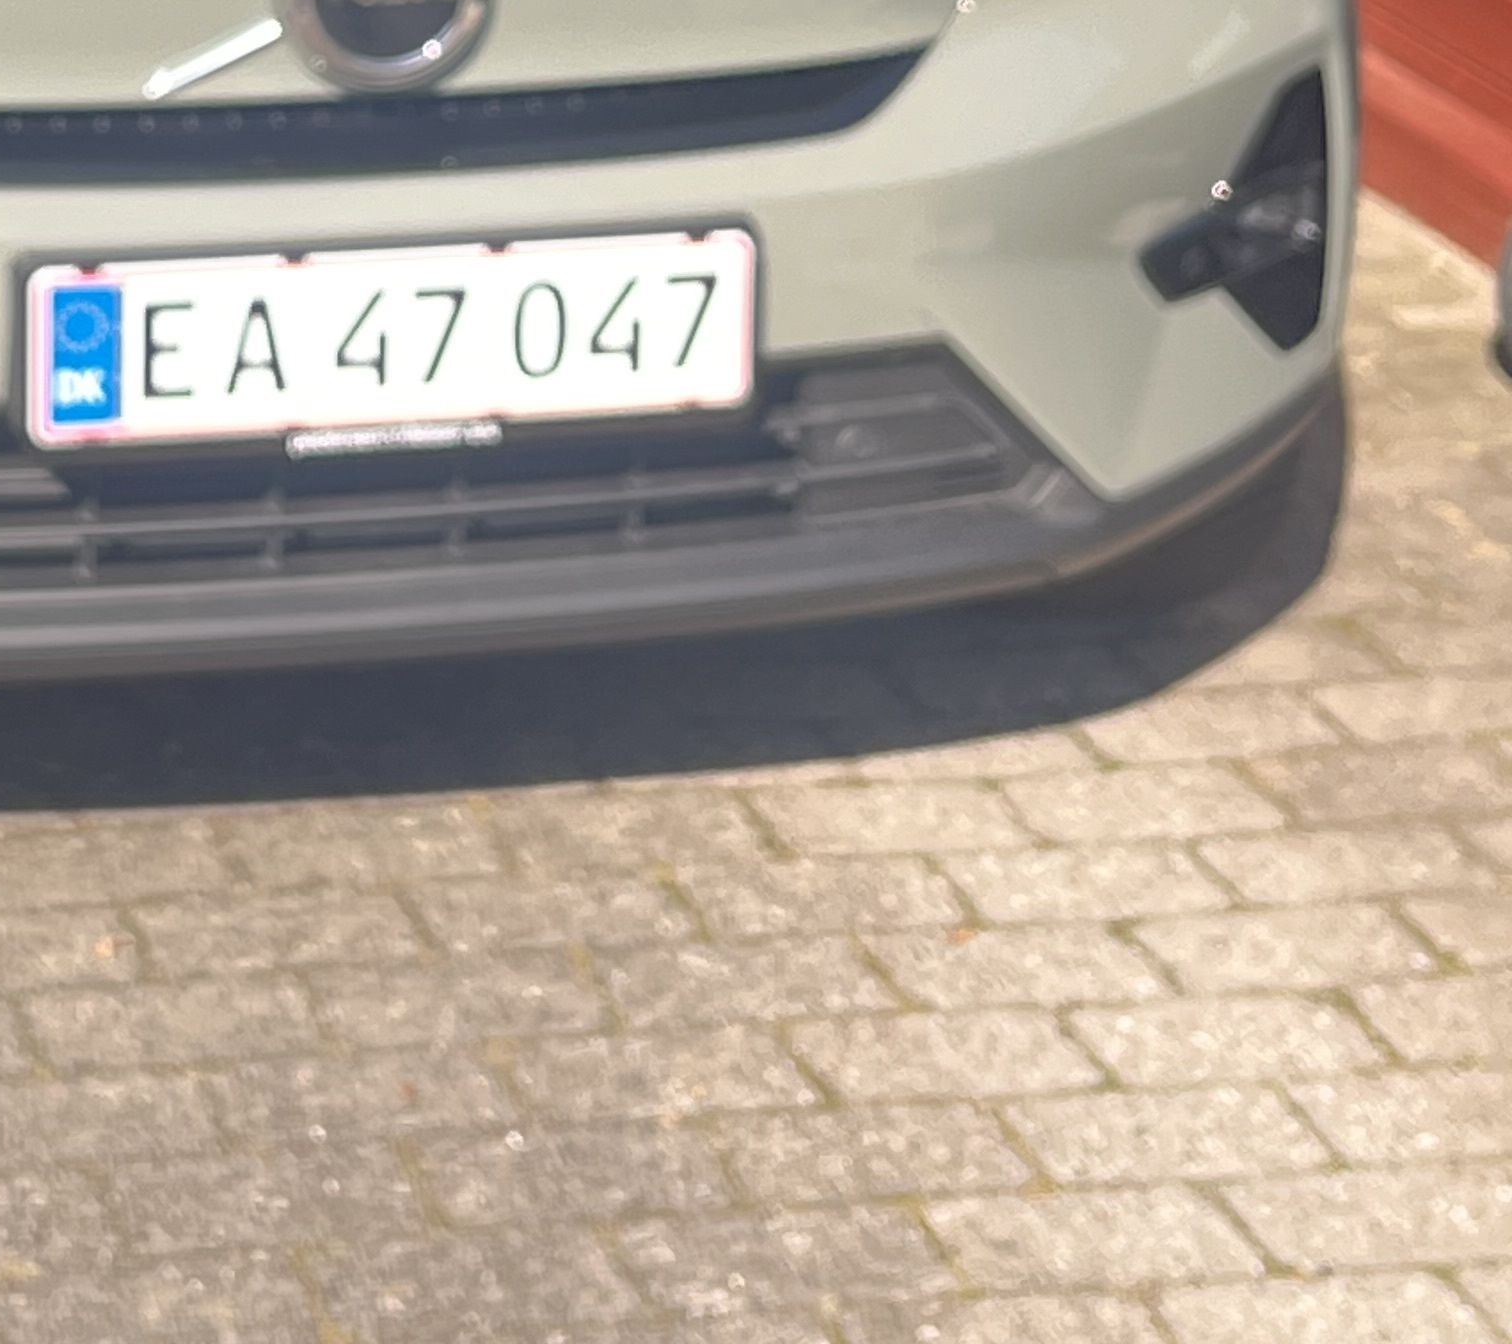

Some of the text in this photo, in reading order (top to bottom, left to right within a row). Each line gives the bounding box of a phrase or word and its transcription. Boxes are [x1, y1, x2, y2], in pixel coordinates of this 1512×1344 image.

[143, 273, 718, 398] EA 47 047
[55, 367, 107, 407] DK
